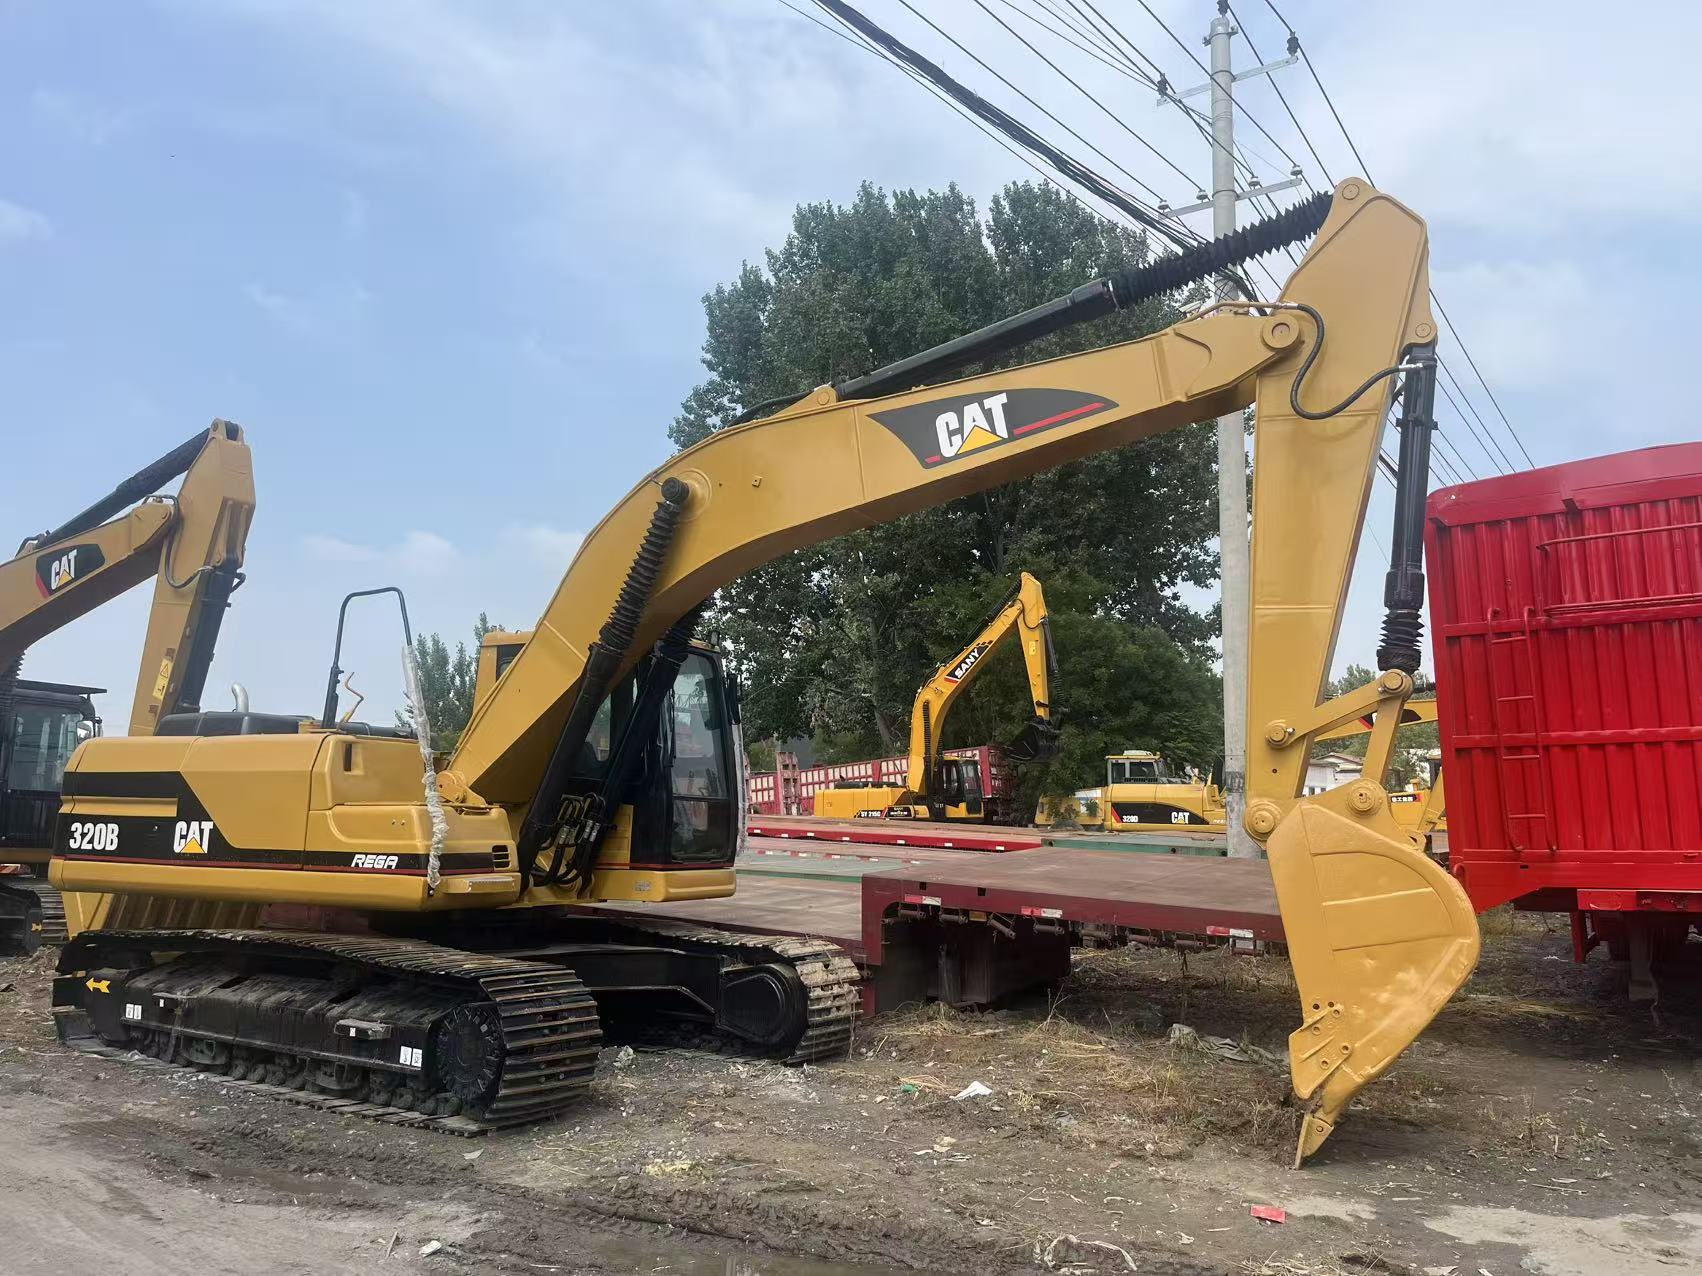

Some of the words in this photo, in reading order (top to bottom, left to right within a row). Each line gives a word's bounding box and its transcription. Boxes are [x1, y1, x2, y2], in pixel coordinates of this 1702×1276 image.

[935, 391, 1009, 458] CAT
[51, 548, 77, 590] CAT
[954, 648, 979, 679] SANY
[1171, 811, 1190, 824] CAT
[69, 822, 120, 851] 320B
[173, 820, 214, 854] CAT
[350, 854, 399, 869] REGA
